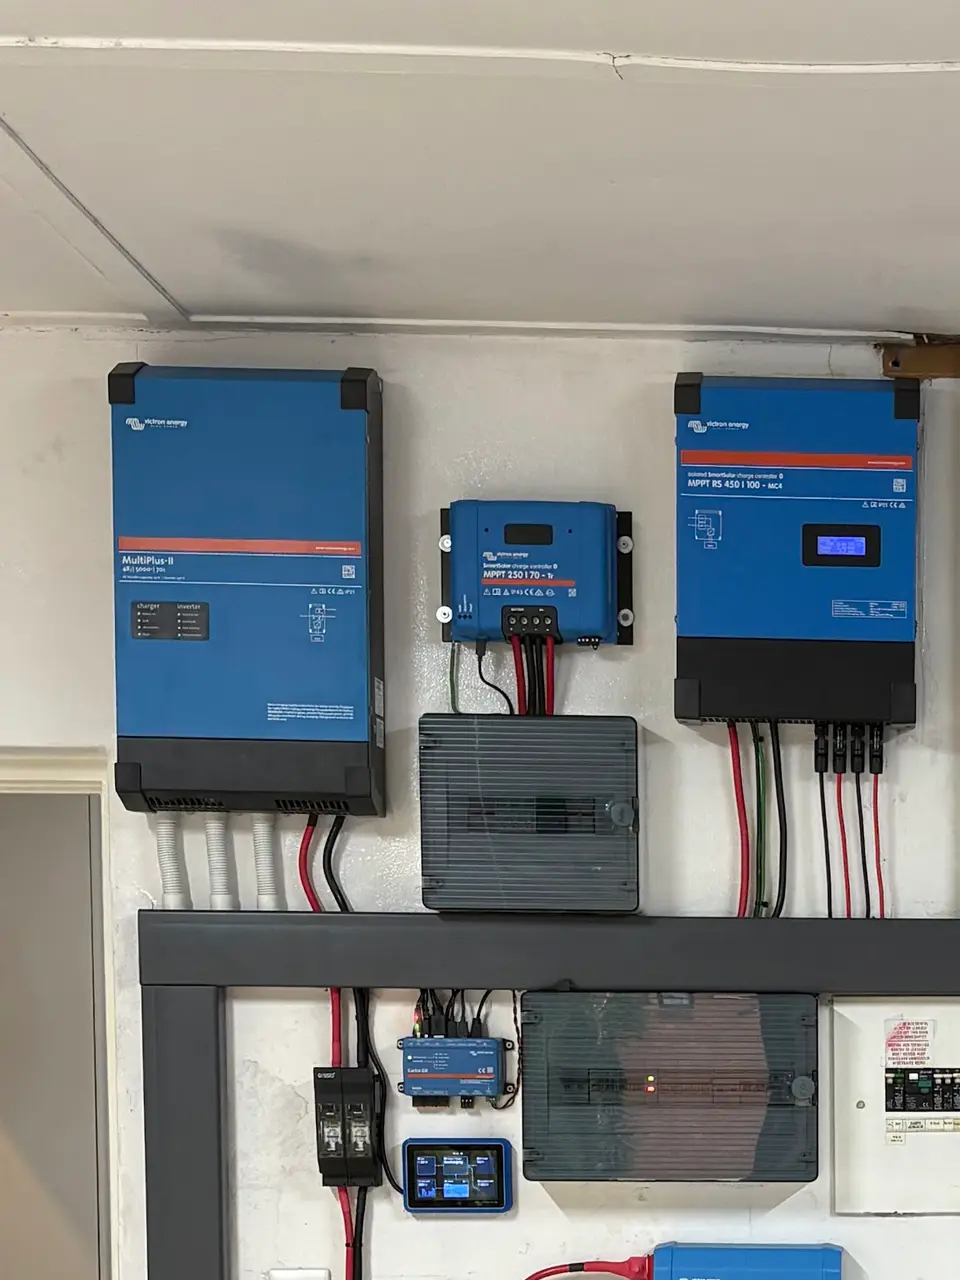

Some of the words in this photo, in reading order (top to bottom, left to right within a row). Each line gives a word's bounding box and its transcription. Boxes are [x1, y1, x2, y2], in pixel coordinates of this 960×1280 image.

[144, 418, 166, 426] victron
[166, 419, 188, 428] energy
[728, 422, 750, 430] energy
[687, 479, 710, 488] MPPT
[712, 479, 722, 488] RS
[724, 480, 740, 489] 450
[746, 481, 760, 490] 100
[122, 555, 174, 566] MultiPlus-II
[483, 570, 507, 579] MPPT
[507, 570, 524, 580] 250
[529, 571, 540, 580] 70
[136, 602, 160, 611] charger
